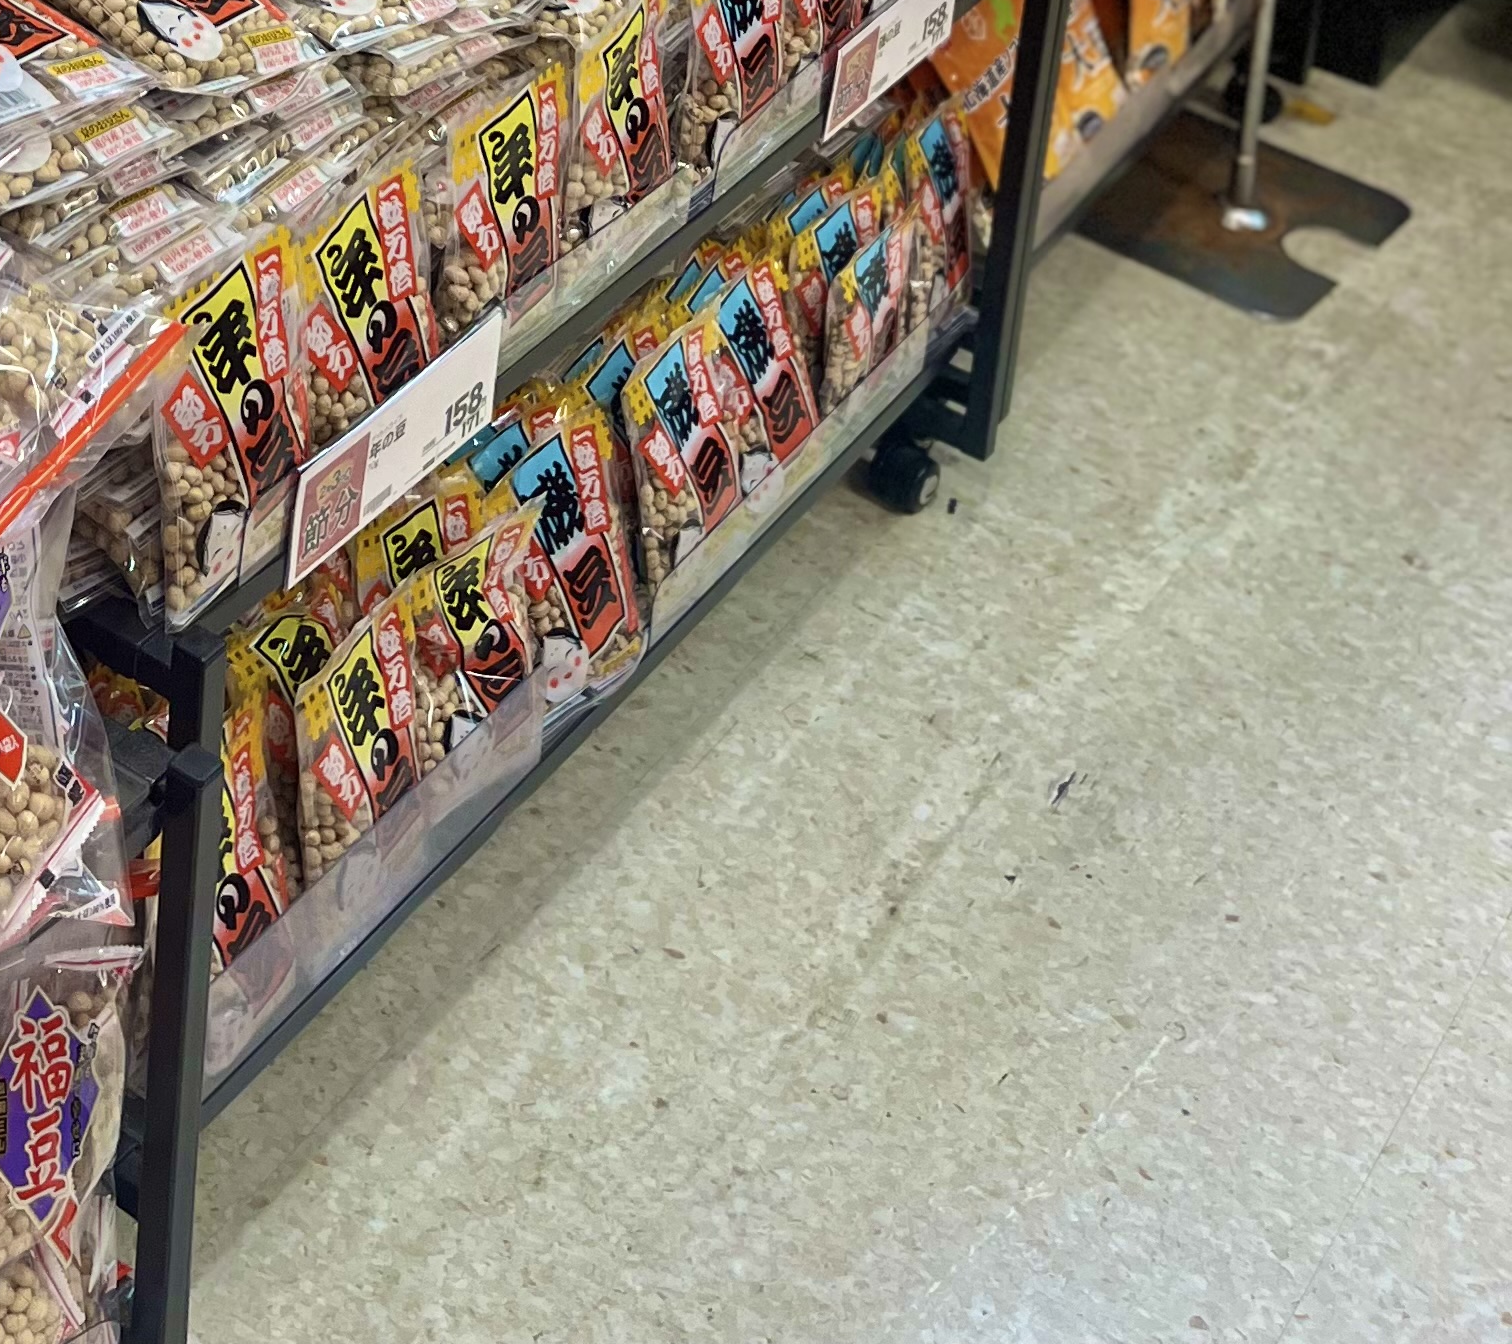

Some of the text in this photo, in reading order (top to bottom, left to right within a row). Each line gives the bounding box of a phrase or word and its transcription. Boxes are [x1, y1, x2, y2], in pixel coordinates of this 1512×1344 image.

[922, 1, 948, 41] 158
[379, 180, 414, 296] 一粒万倍
[257, 252, 287, 377] 一粒万倍
[368, 418, 408, 459] 年の豆
[444, 381, 484, 437] 158
[461, 415, 481, 438] 171
[572, 429, 608, 532] 一粒万倍
[302, 484, 361, 559] 節分
[9, 1014, 76, 1202] 福豆
